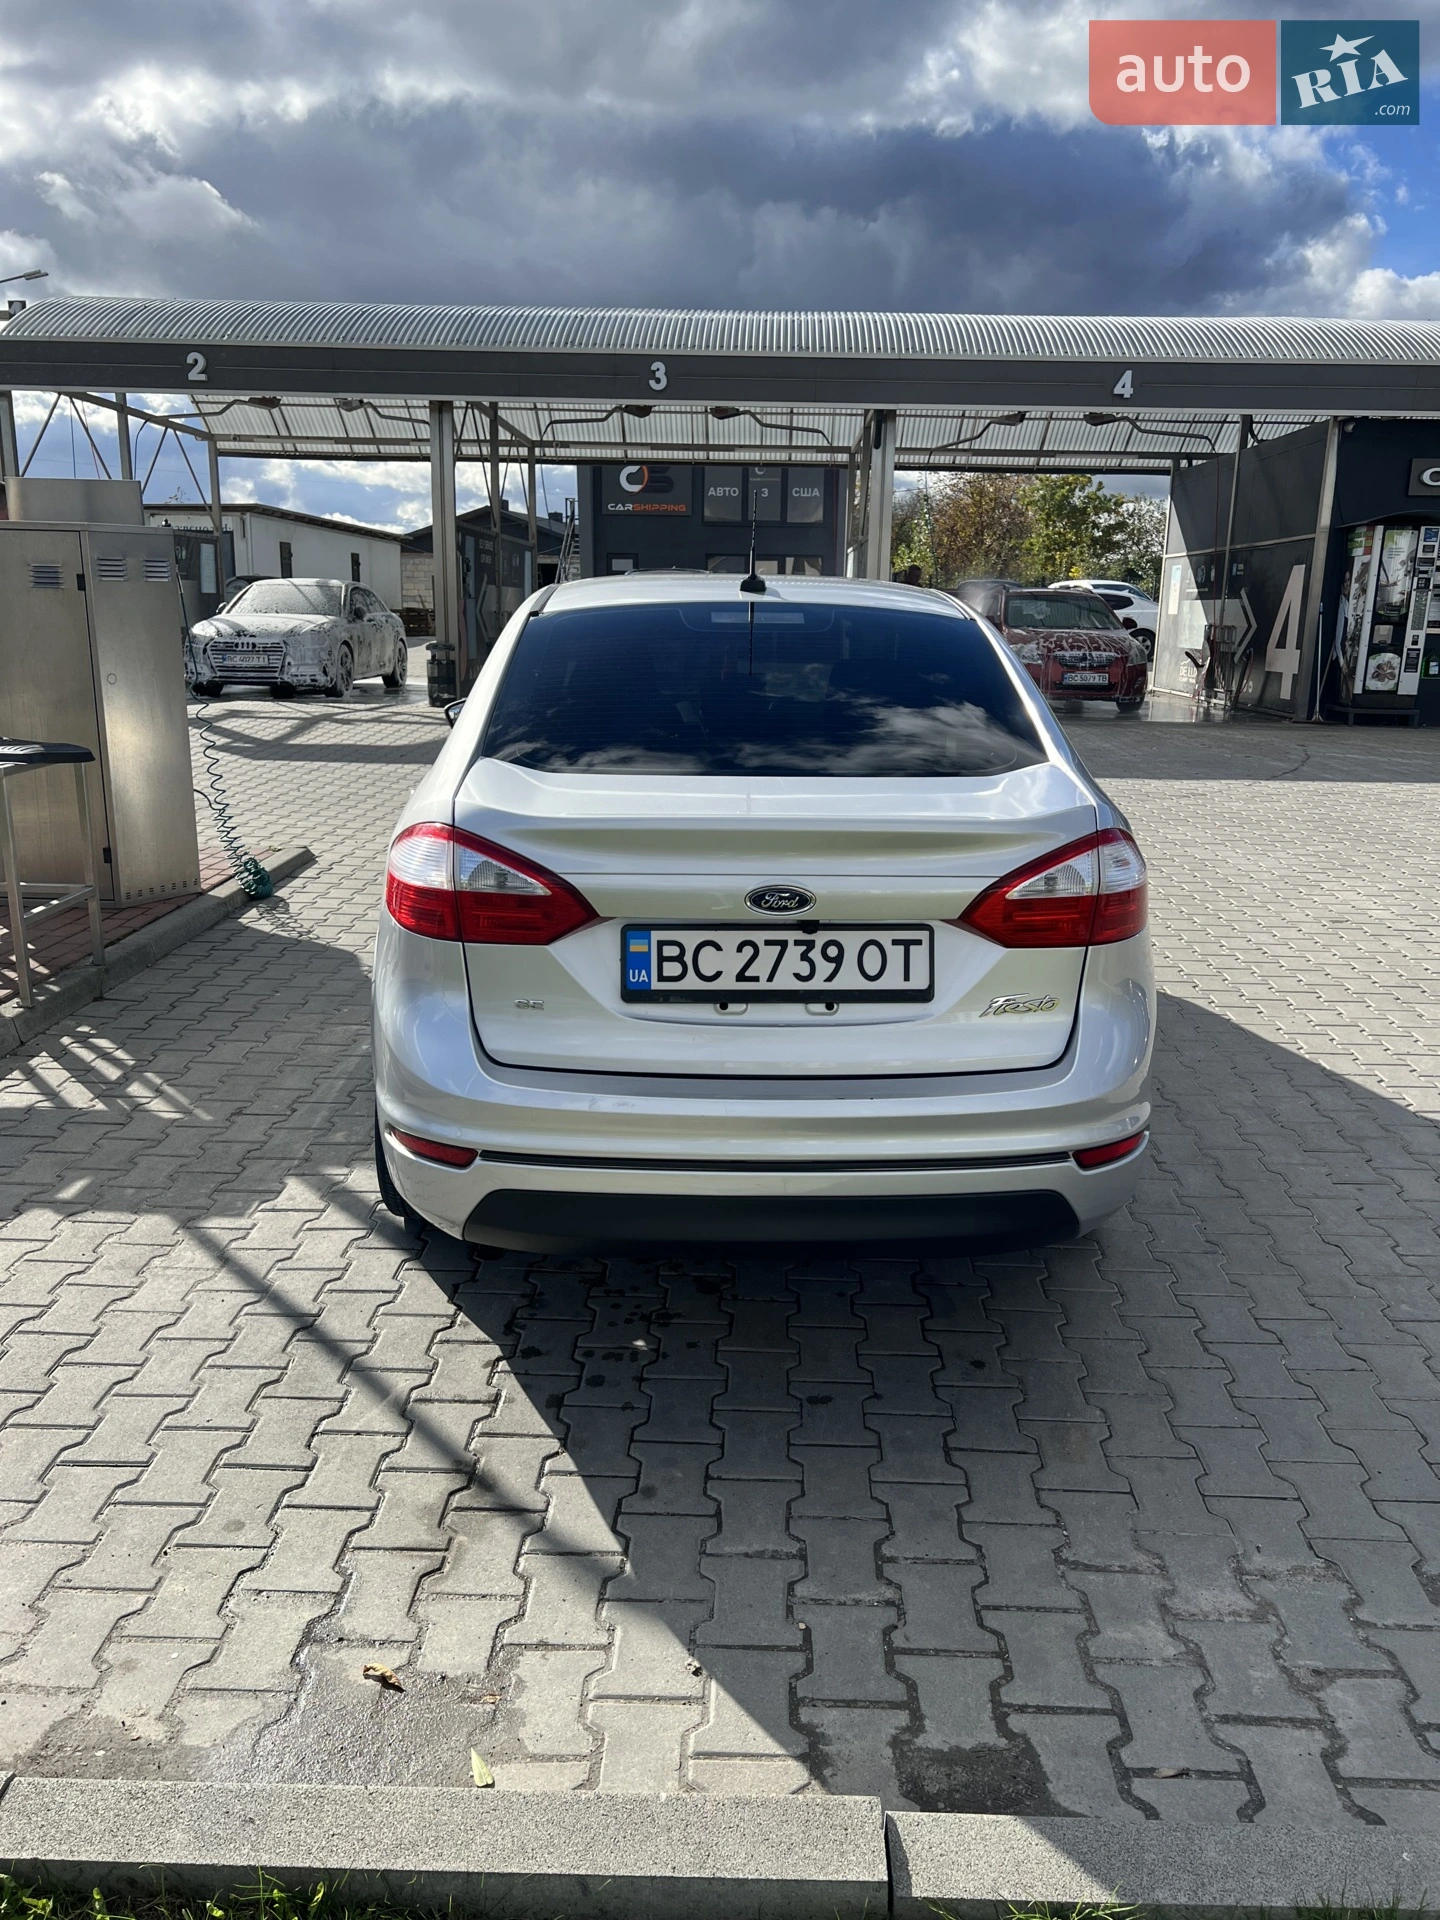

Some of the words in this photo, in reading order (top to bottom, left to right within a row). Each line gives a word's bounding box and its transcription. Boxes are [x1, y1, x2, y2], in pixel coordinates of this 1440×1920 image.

[186, 351, 208, 382] 2
[648, 361, 668, 391] 3
[1113, 370, 1134, 398] 4
[708, 486, 739, 497] АВТО
[792, 487, 820, 497] США
[607, 503, 687, 512] CARSHIPPING
[1265, 564, 1306, 700] 4
[761, 892, 800, 908] Ford
[656, 940, 724, 983] BC
[735, 940, 845, 983] 2739
[857, 939, 923, 983] OT
[629, 969, 649, 983] UA
[514, 999, 545, 1010] SE
